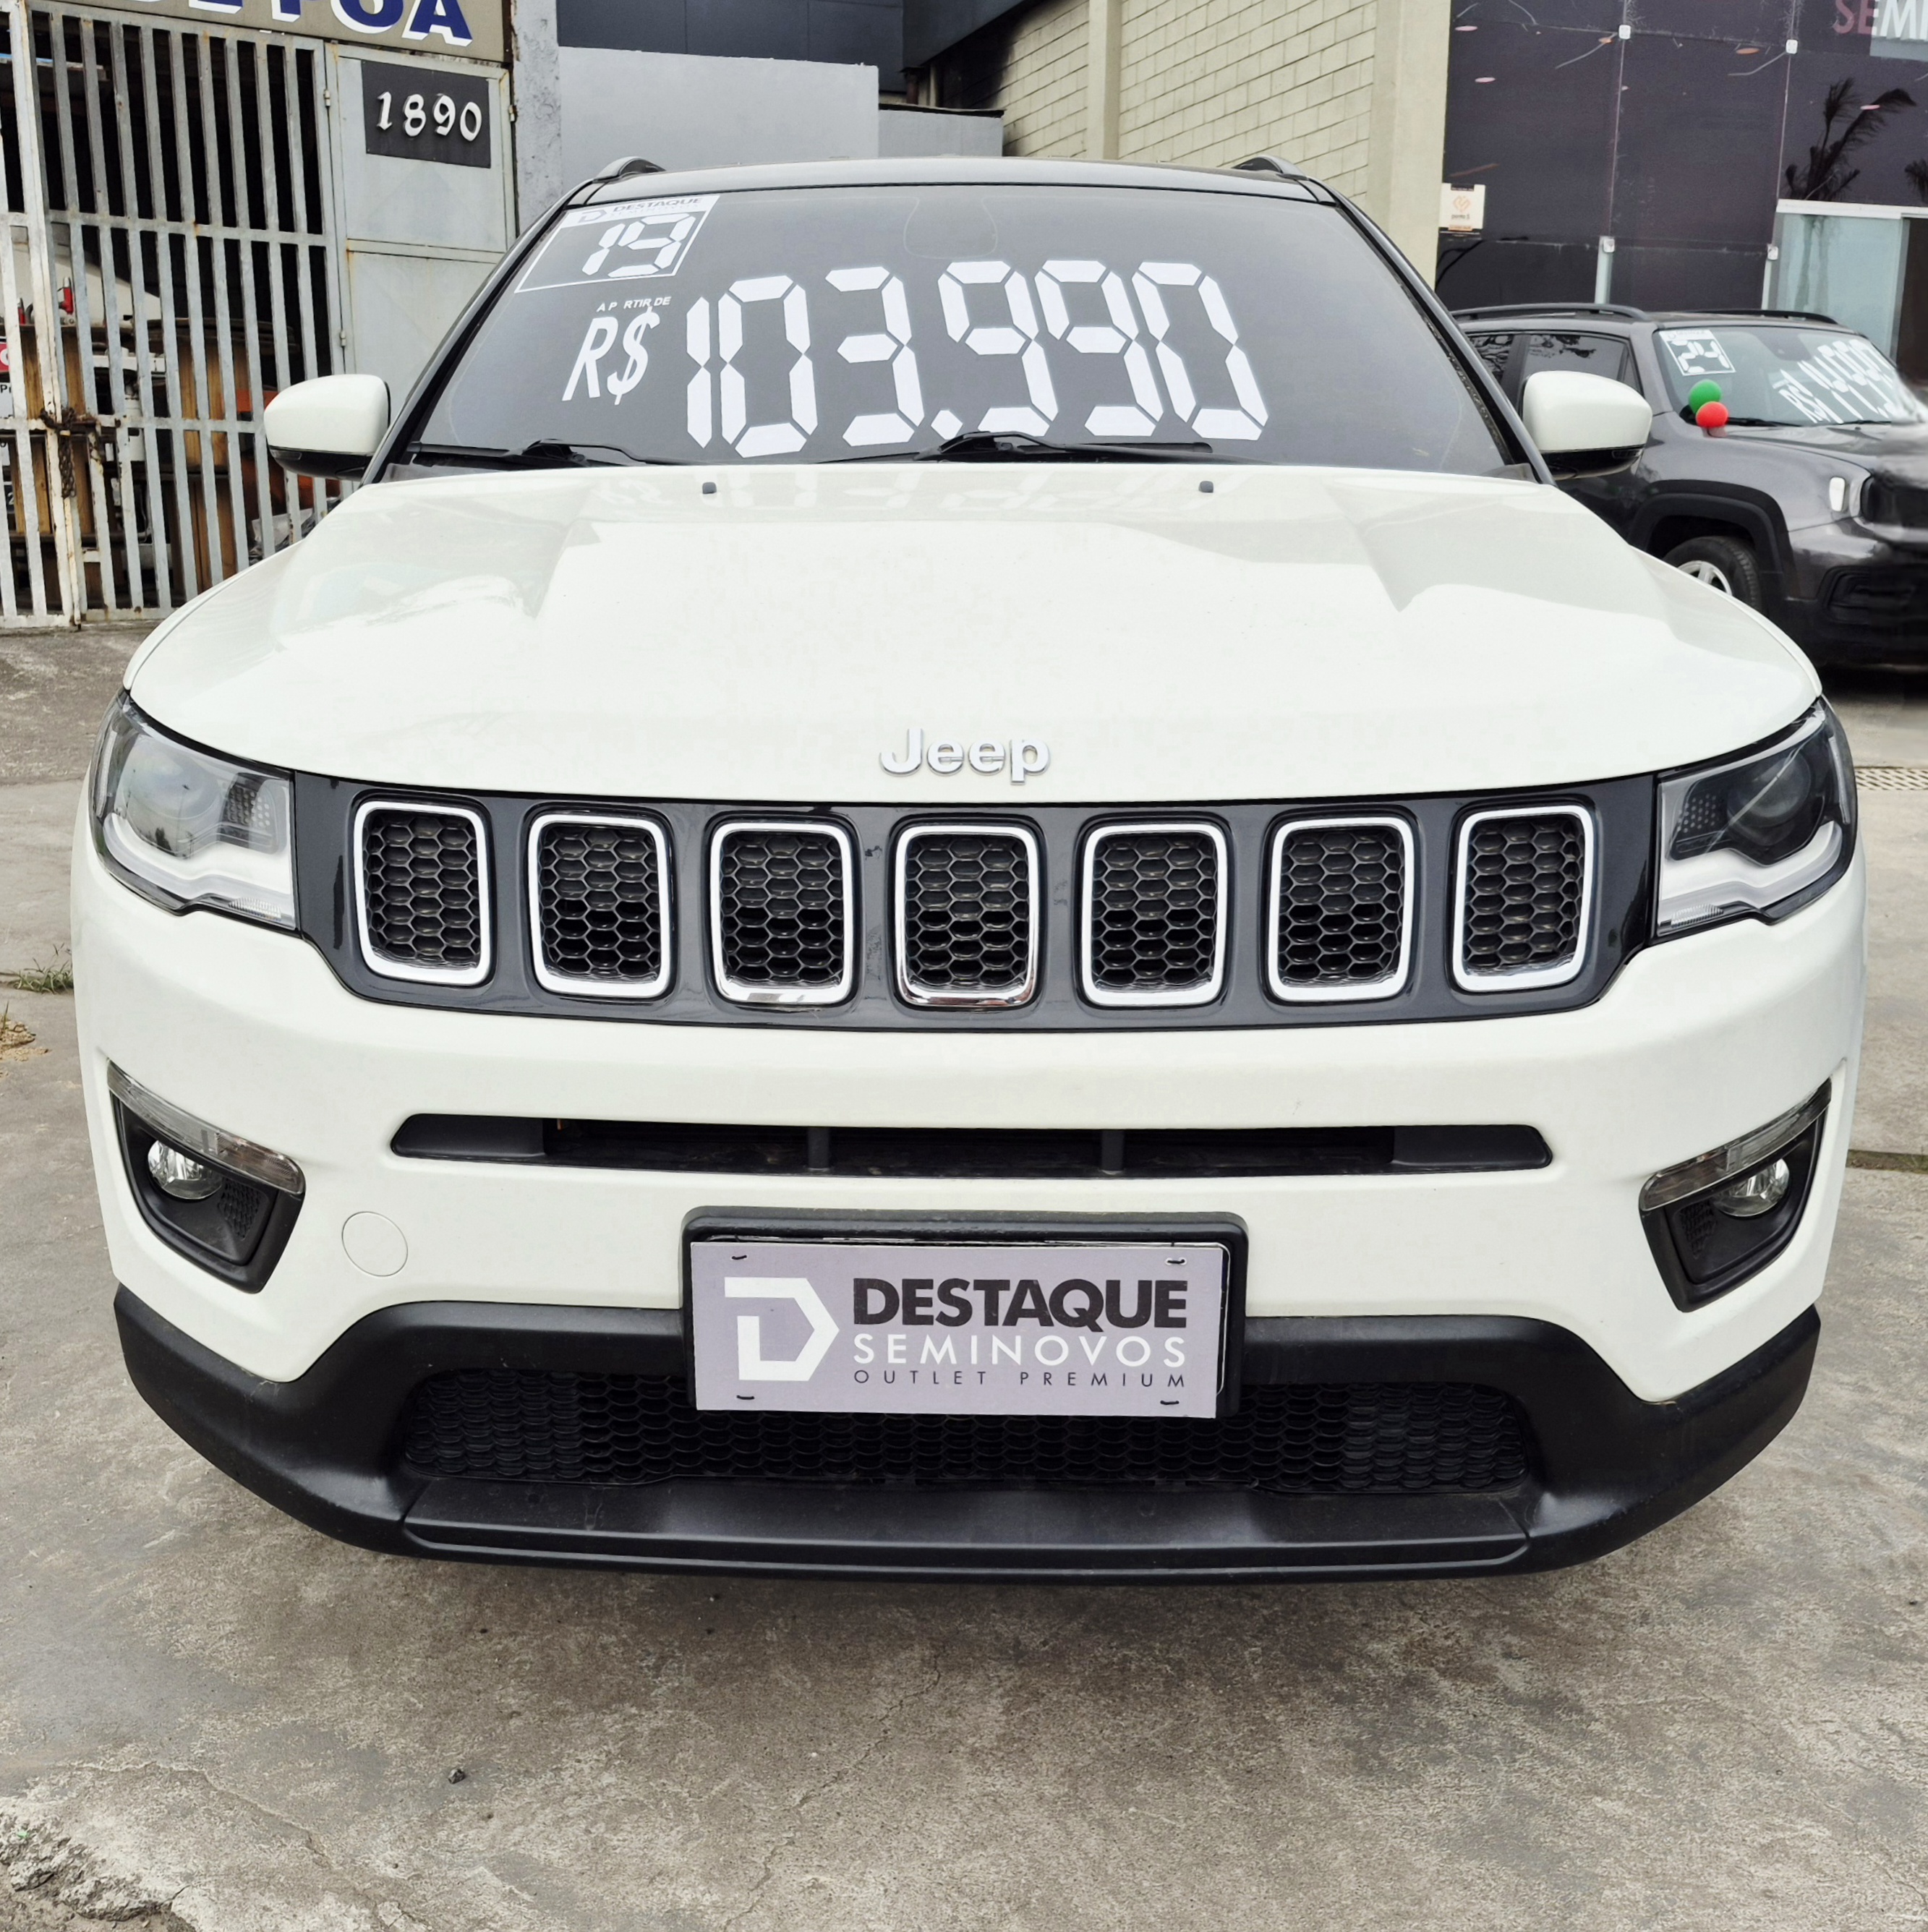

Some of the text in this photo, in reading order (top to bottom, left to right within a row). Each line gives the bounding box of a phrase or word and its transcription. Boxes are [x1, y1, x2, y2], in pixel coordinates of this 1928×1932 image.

[377, 91, 482, 142] 1890
[613, 197, 704, 213] DESTAQUE
[581, 213, 696, 278] 19
[653, 296, 672, 307] DE
[561, 260, 1269, 458] R$ 103.990
[1671, 340, 1731, 373] 24
[879, 727, 1052, 786] Jeep
[853, 1276, 1188, 1333] DESTAQUE
[853, 1333, 1187, 1369] SEMINOVOS
[853, 1369, 1186, 1389] OUTLET PREMIUM
